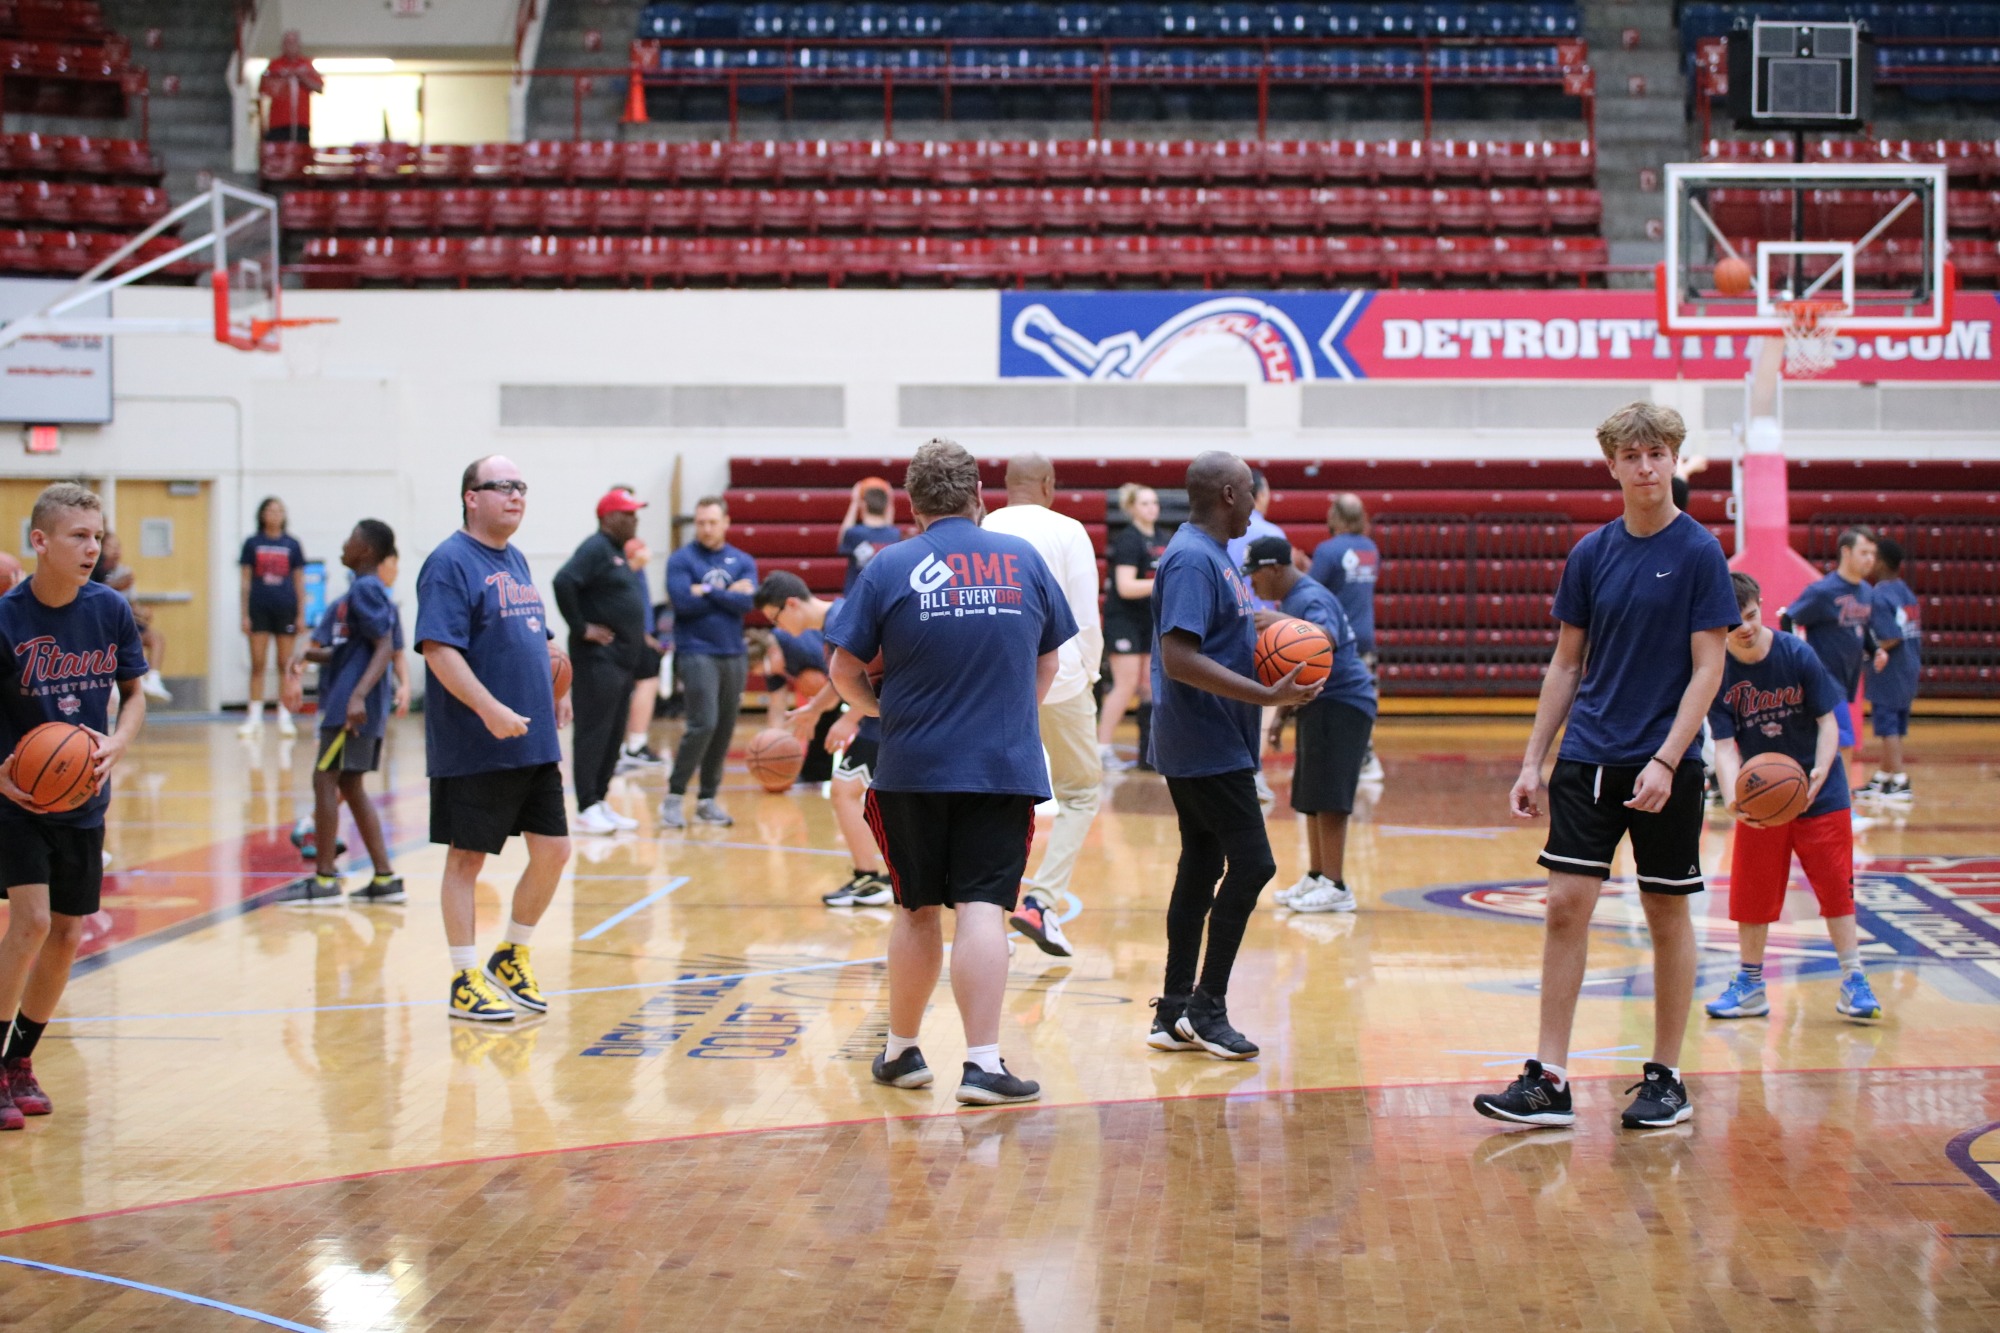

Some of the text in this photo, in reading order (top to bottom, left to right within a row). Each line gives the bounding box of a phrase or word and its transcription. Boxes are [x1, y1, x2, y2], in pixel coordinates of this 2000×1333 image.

[1382, 318, 1992, 360] DETROITTIT.COM
[484, 571, 541, 608] Tita
[909, 552, 1022, 593] GAME
[920, 592, 950, 610] ALL
[15, 635, 118, 687] Titans
[1736, 705, 1804, 731] SKETBAL
[579, 1022, 696, 1058] DICK
[686, 1002, 827, 1059] COURT
